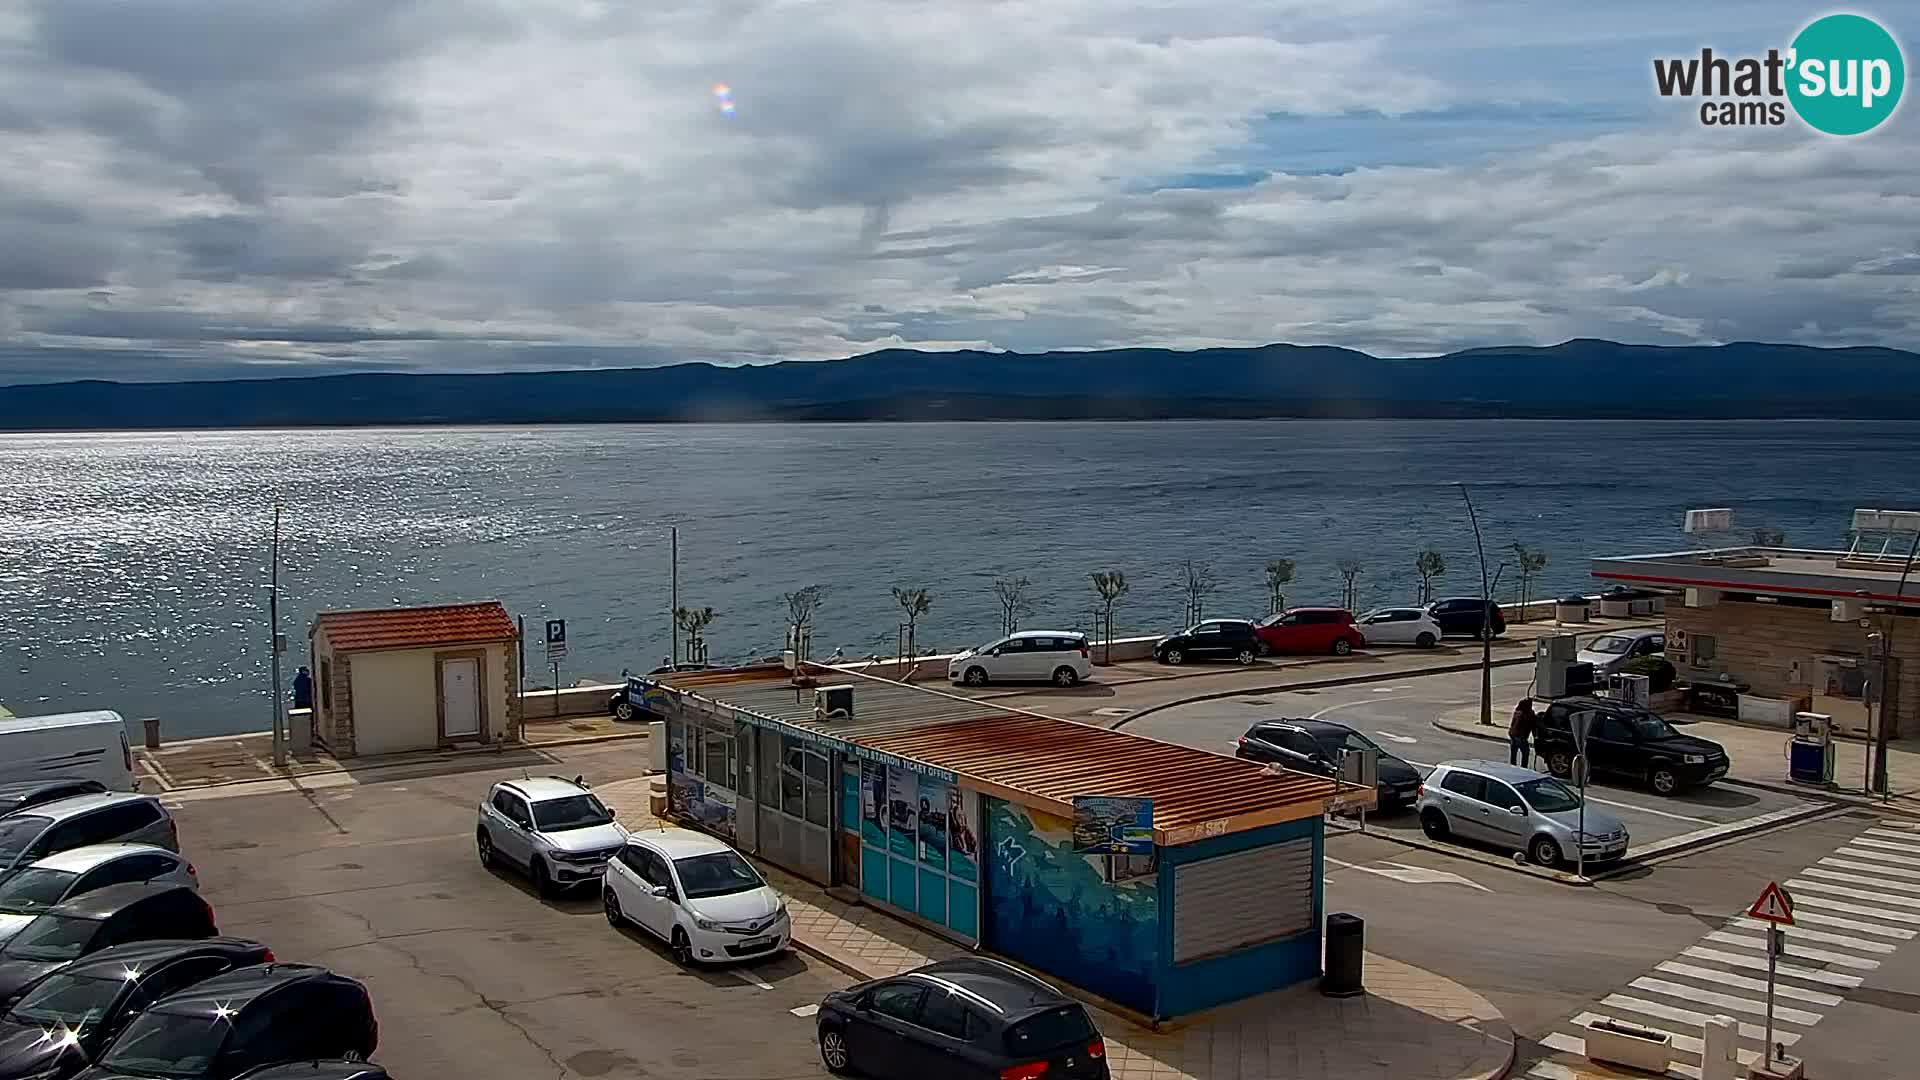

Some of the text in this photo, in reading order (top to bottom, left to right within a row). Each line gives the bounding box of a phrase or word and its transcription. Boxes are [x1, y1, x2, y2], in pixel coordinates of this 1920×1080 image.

[551, 623, 561, 640] P
[856, 747, 870, 758] BUS
[870, 751, 900, 767] STATION
[902, 760, 927, 775] TICKET
[928, 768, 953, 782] OFFICE
